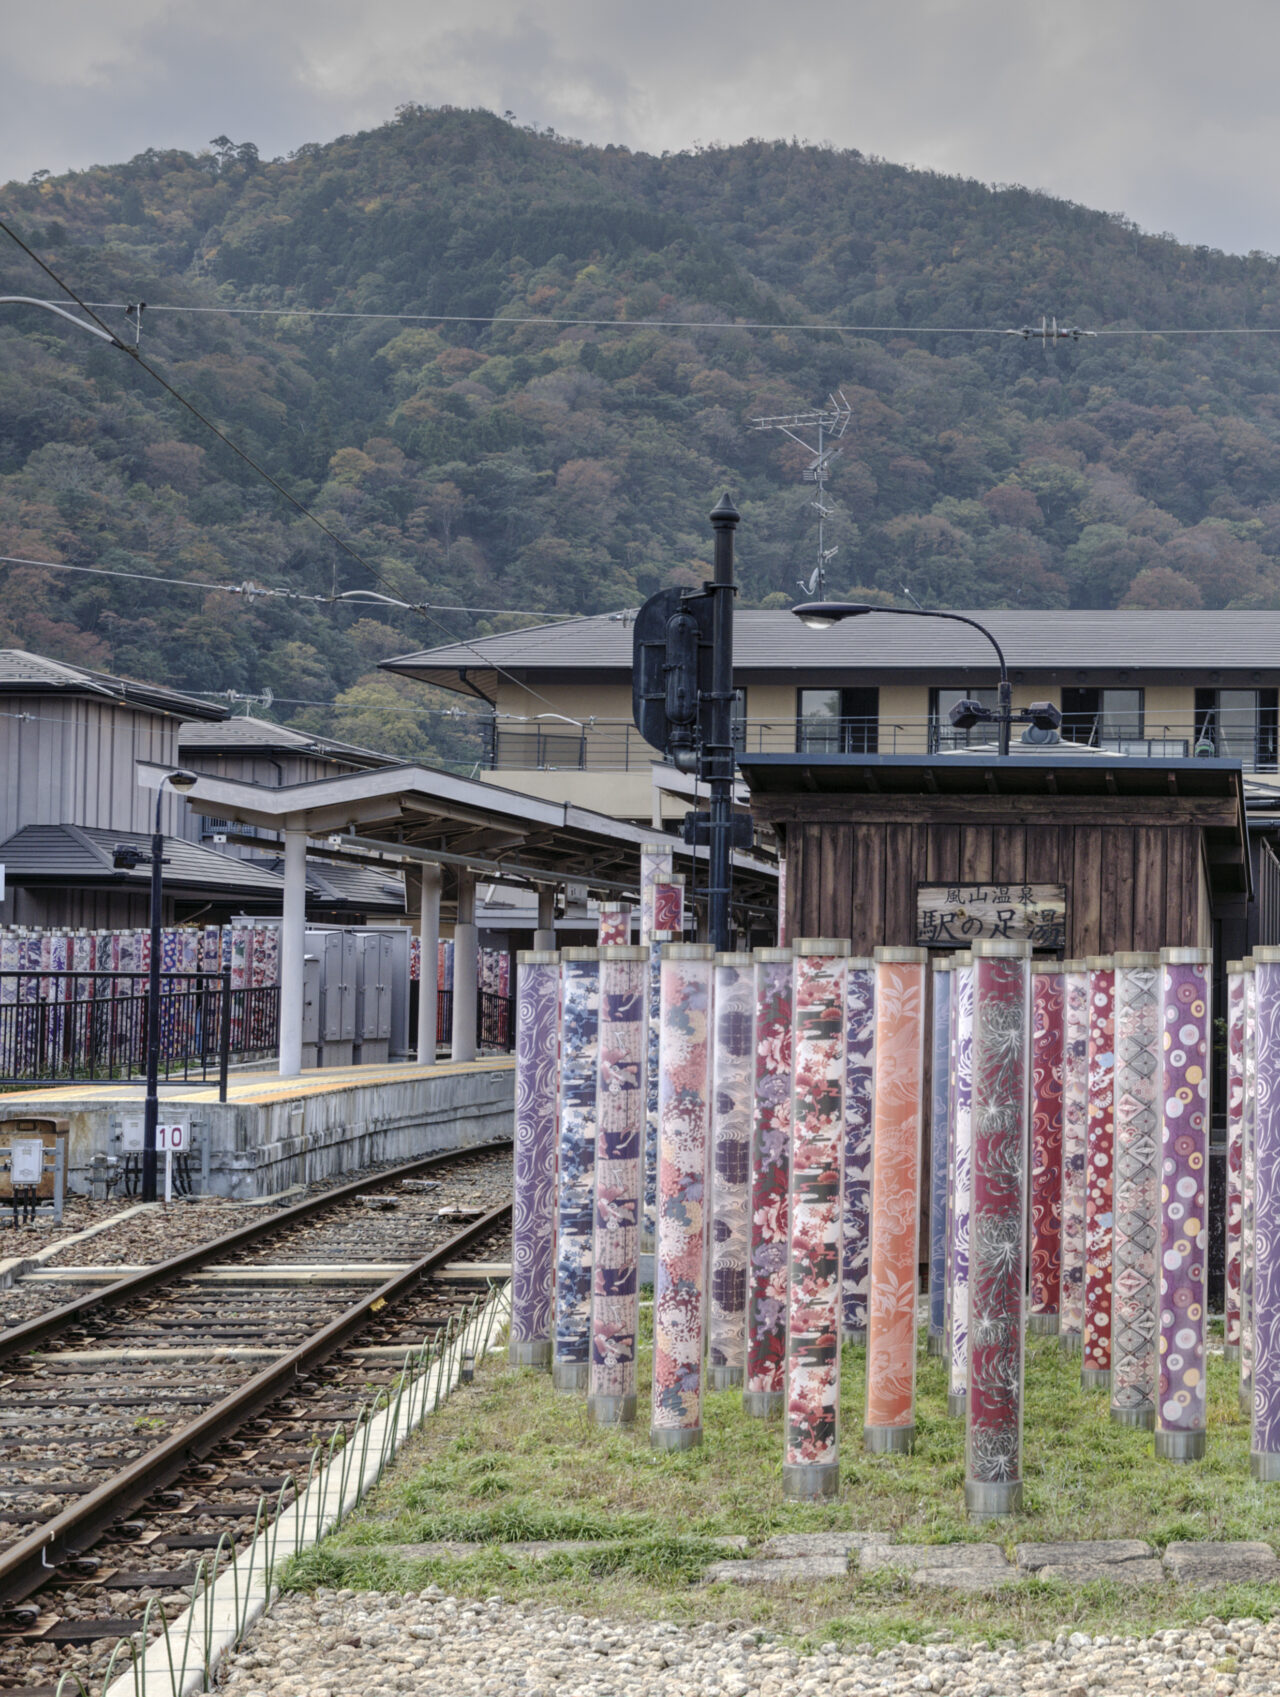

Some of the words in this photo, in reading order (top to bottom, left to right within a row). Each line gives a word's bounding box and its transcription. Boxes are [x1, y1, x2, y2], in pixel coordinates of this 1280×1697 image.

[919, 908, 1066, 946] 駅の足湯
[159, 1127, 183, 1148] 10
